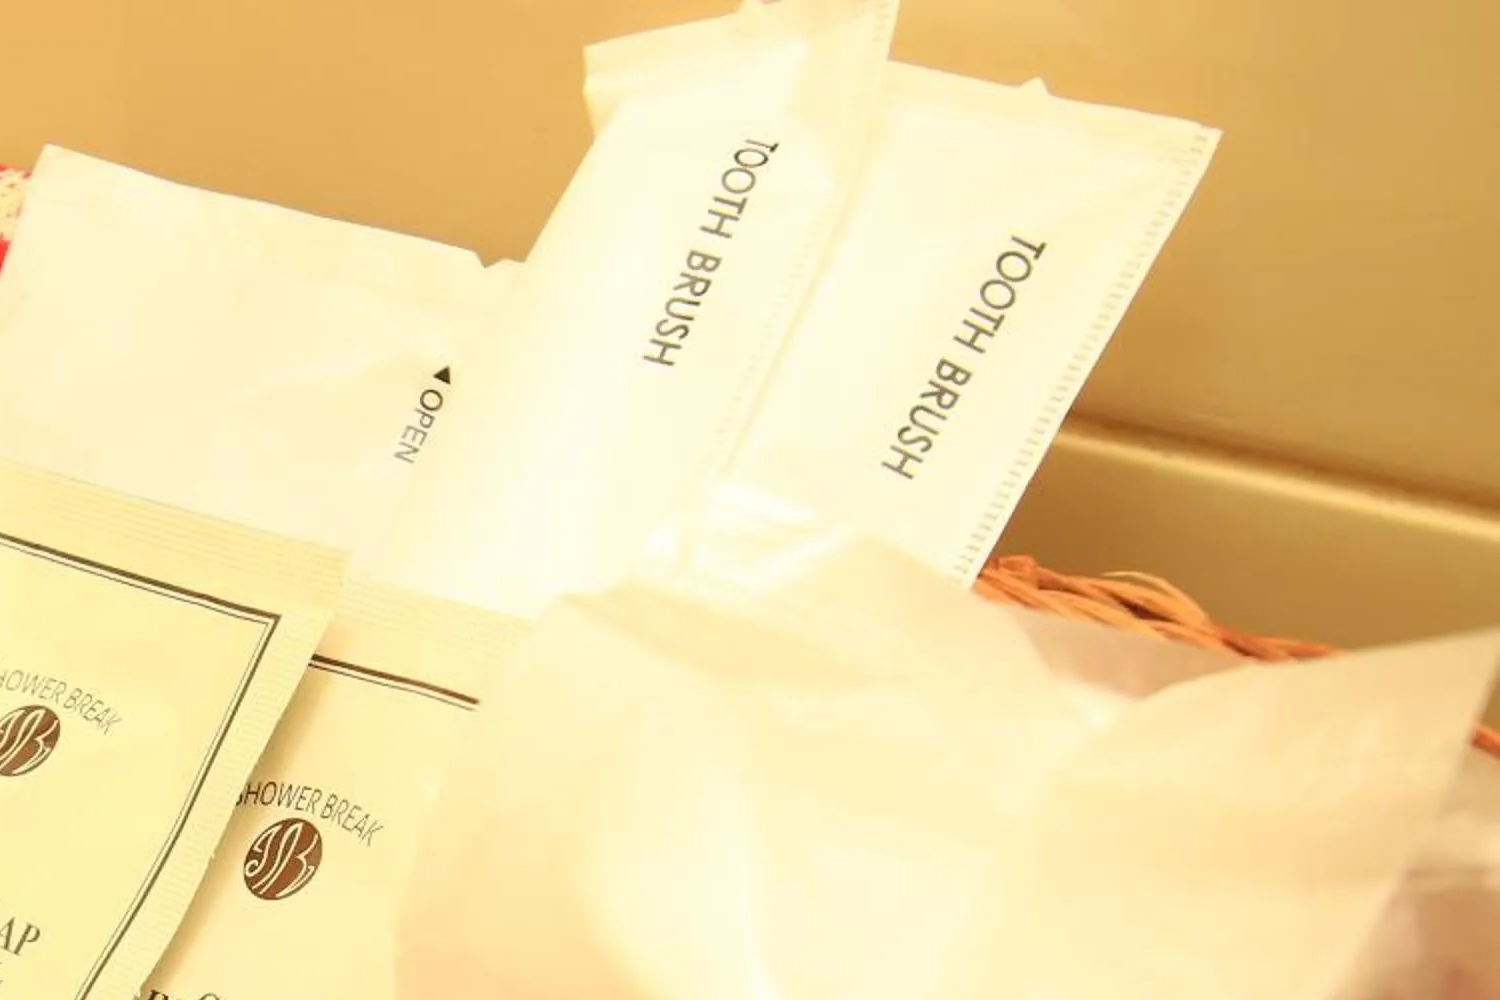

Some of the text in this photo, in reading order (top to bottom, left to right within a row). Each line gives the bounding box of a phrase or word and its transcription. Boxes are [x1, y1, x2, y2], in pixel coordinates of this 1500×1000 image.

[642, 137, 780, 368] TOOTH BRUSH
[880, 234, 1047, 480] TOOTH BRUSH
[393, 388, 444, 464] OPEN
[63, 687, 123, 735] BREAK
[319, 793, 384, 848] BREAK
